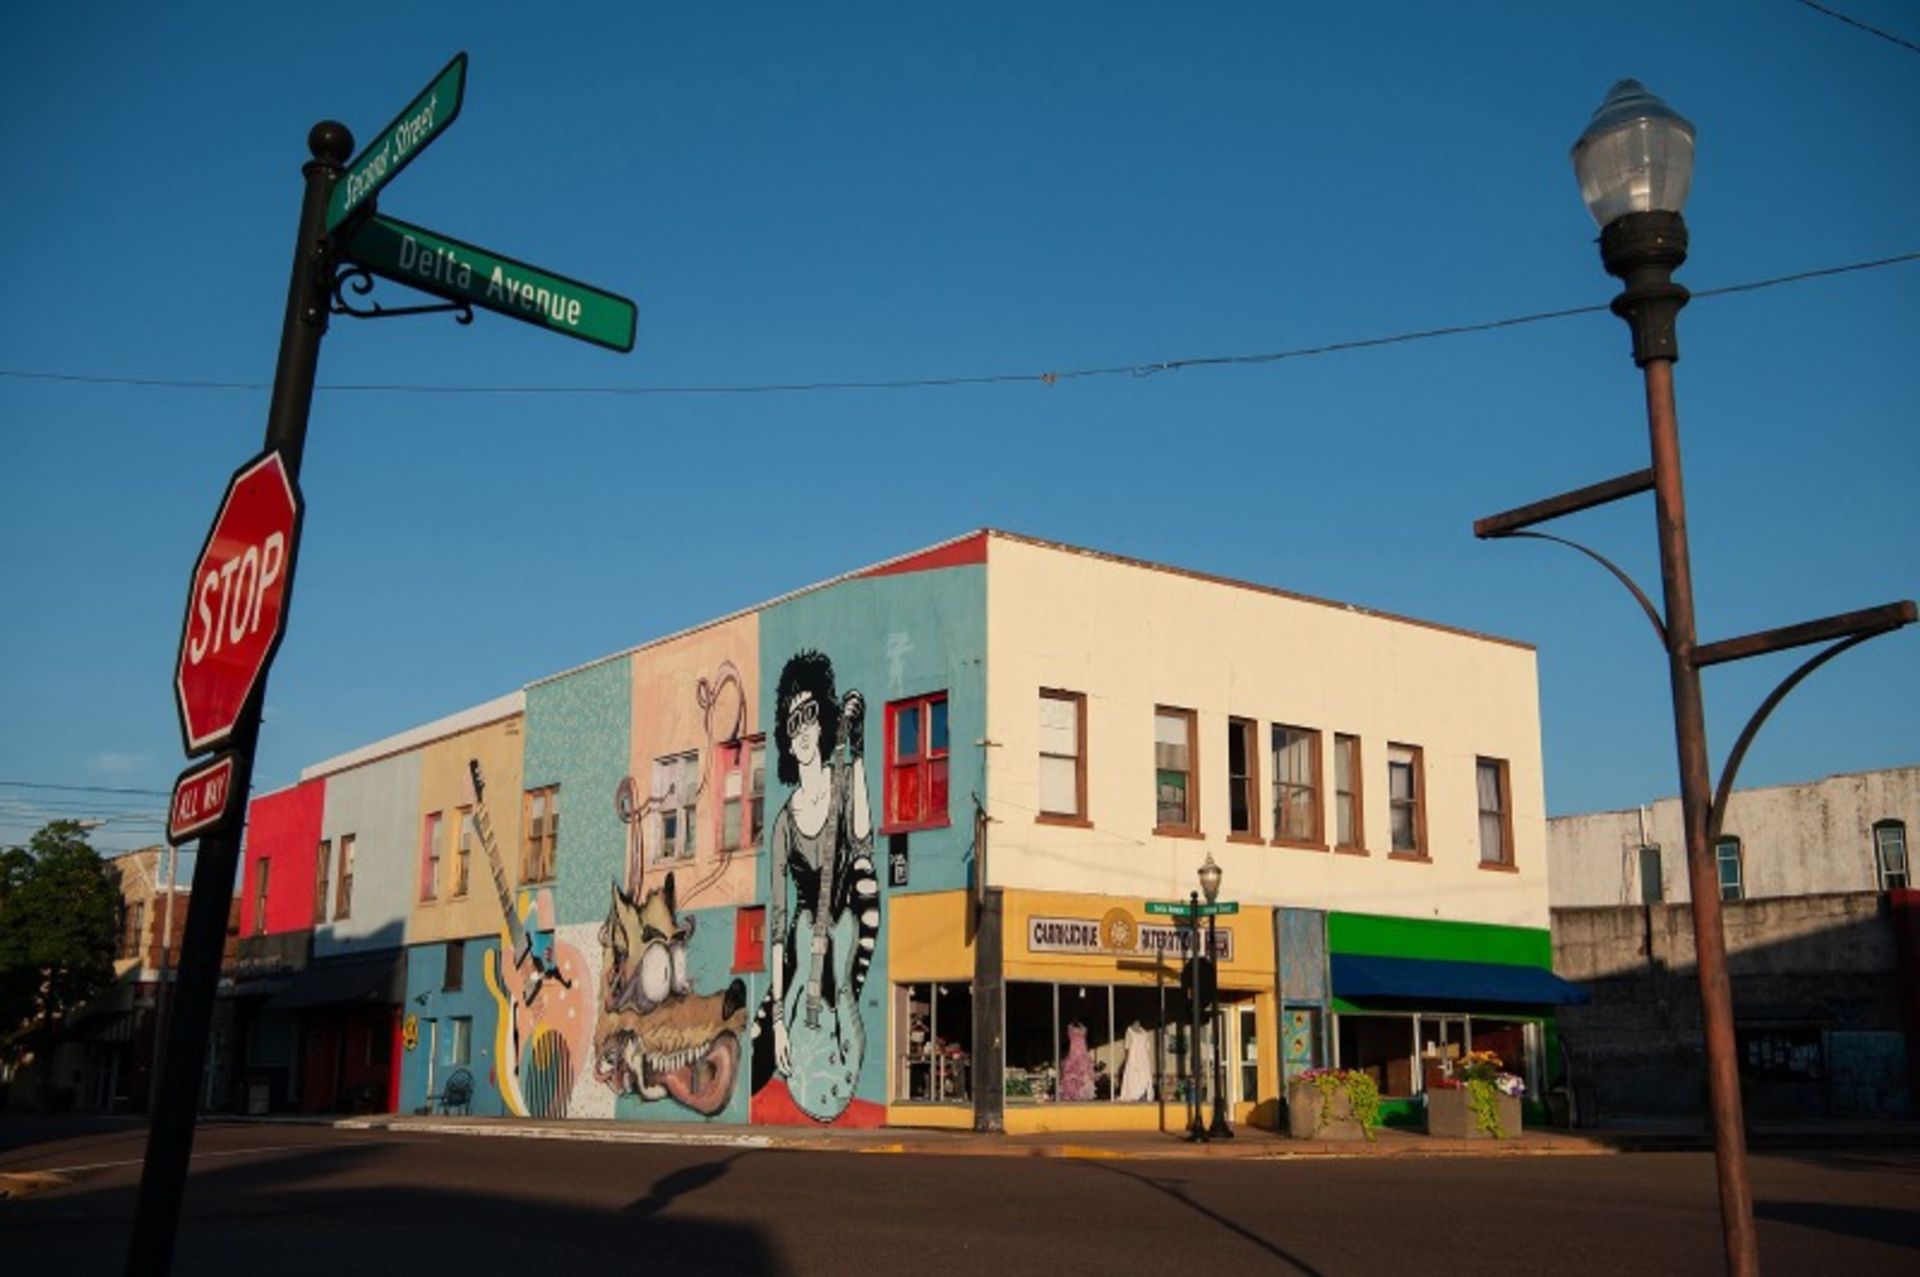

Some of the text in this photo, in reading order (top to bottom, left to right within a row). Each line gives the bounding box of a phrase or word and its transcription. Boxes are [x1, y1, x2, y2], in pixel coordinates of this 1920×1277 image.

[344, 94, 437, 210] Second Street
[399, 234, 582, 326] Delta Avenue
[190, 531, 284, 666] STOP
[177, 772, 226, 823] ALL WAY
